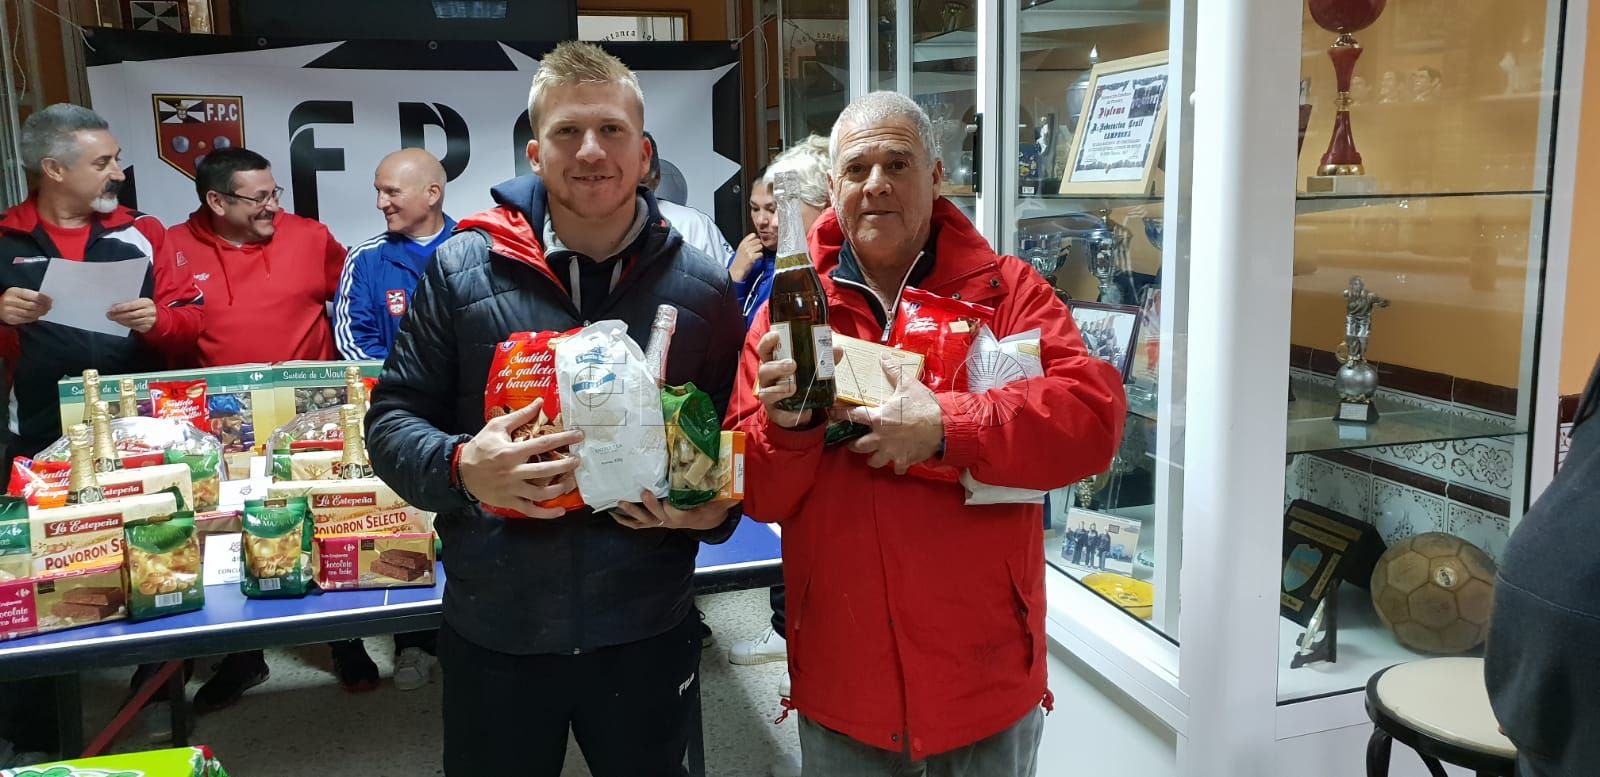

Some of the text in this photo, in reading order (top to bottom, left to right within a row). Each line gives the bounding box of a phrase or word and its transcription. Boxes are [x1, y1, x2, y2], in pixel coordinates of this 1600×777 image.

[510, 350, 552, 364] Surtido
[498, 365, 513, 377] de
[494, 382, 504, 393] y
[316, 494, 373, 507] La Estepeña
[49, 518, 119, 535] La Estepeña
[366, 511, 407, 529] SELECTO
[44, 542, 108, 571] POLVORON
